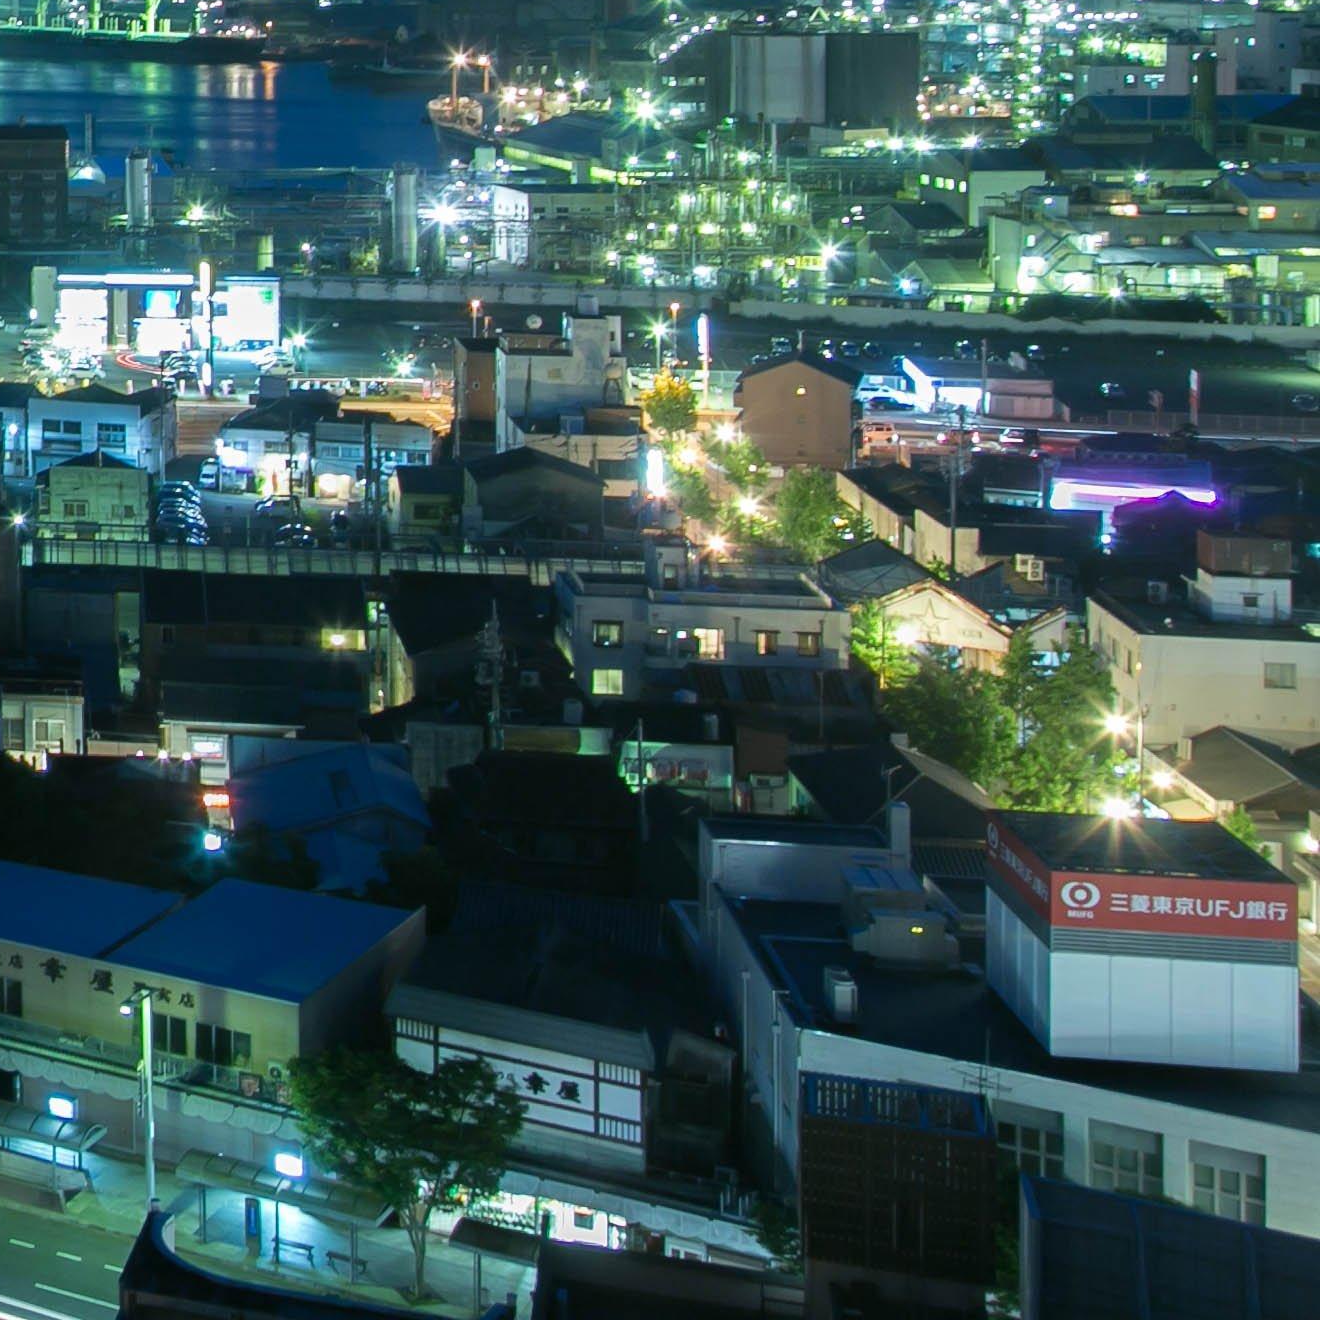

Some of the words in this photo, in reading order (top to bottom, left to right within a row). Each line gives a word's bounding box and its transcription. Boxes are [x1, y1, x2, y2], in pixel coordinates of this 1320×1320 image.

[1067, 909, 1094, 919] MUFG
[1109, 892, 1289, 922] 三菱東京UFJ銀行
